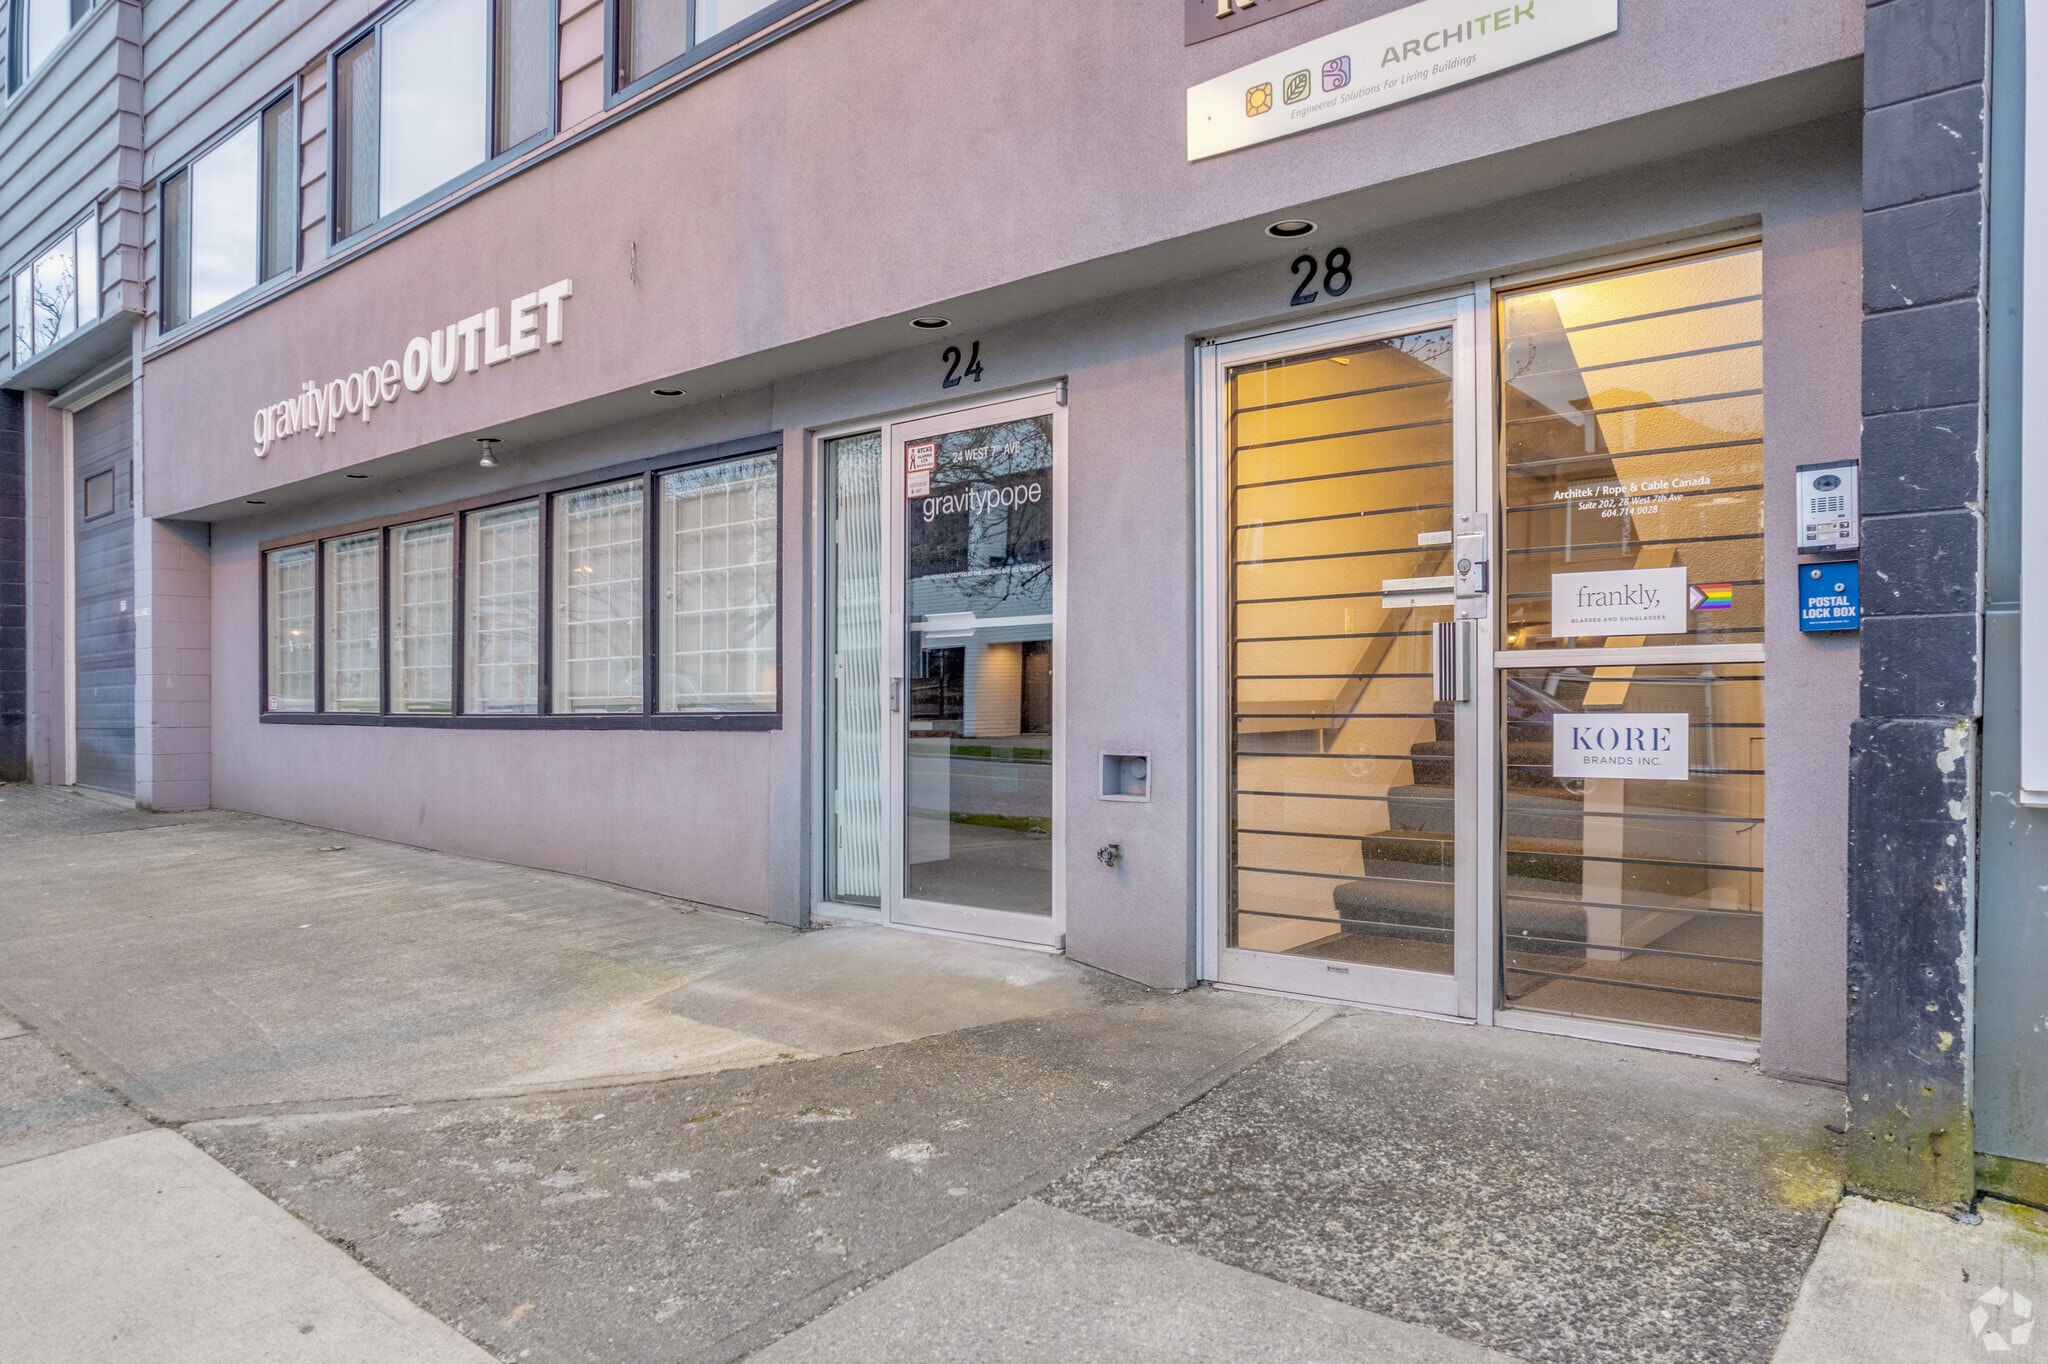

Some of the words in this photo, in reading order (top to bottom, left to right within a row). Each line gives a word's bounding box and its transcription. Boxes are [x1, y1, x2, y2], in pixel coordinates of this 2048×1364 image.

[1381, 0, 1535, 68] ARCHITEK
[1290, 97, 1337, 119] Engineered
[1339, 83, 1381, 105] Solutions
[1383, 78, 1399, 92] For
[1401, 69, 1429, 85] Living
[1432, 53, 1477, 74] Buildings
[1290, 247, 1352, 306] 28
[942, 341, 984, 389] 24
[952, 451, 963, 463] 24
[965, 446, 989, 461] WEST
[1004, 441, 1021, 455] AVE
[1553, 486, 1593, 500] Architek
[1594, 486, 1600, 497] /
[1602, 485, 1627, 498] Rope
[1630, 482, 1638, 492] &
[1641, 479, 1669, 491] Cable
[1671, 476, 1711, 488] Canada
[923, 482, 1042, 522] gravitypope
[1578, 501, 1597, 511] Suite
[1598, 499, 1616, 509] 202,
[1618, 497, 1629, 506] 28
[1631, 495, 1651, 505] West
[1653, 494, 1667, 503] 7th
[1668, 492, 1684, 502] Ave
[1601, 505, 1658, 518] 604.714.0028
[1576, 583, 1661, 610] frankly,
[1808, 596, 1850, 608] POSTAL
[1571, 616, 1601, 624] GLASSES
[1620, 614, 1667, 622] SUNGLASSES
[1802, 607, 1831, 619] LOCK
[1833, 606, 1857, 617] BOX
[1571, 727, 1671, 751] KORE
[1583, 755, 1633, 765] BRANDS
[1638, 756, 1662, 766] INC.
